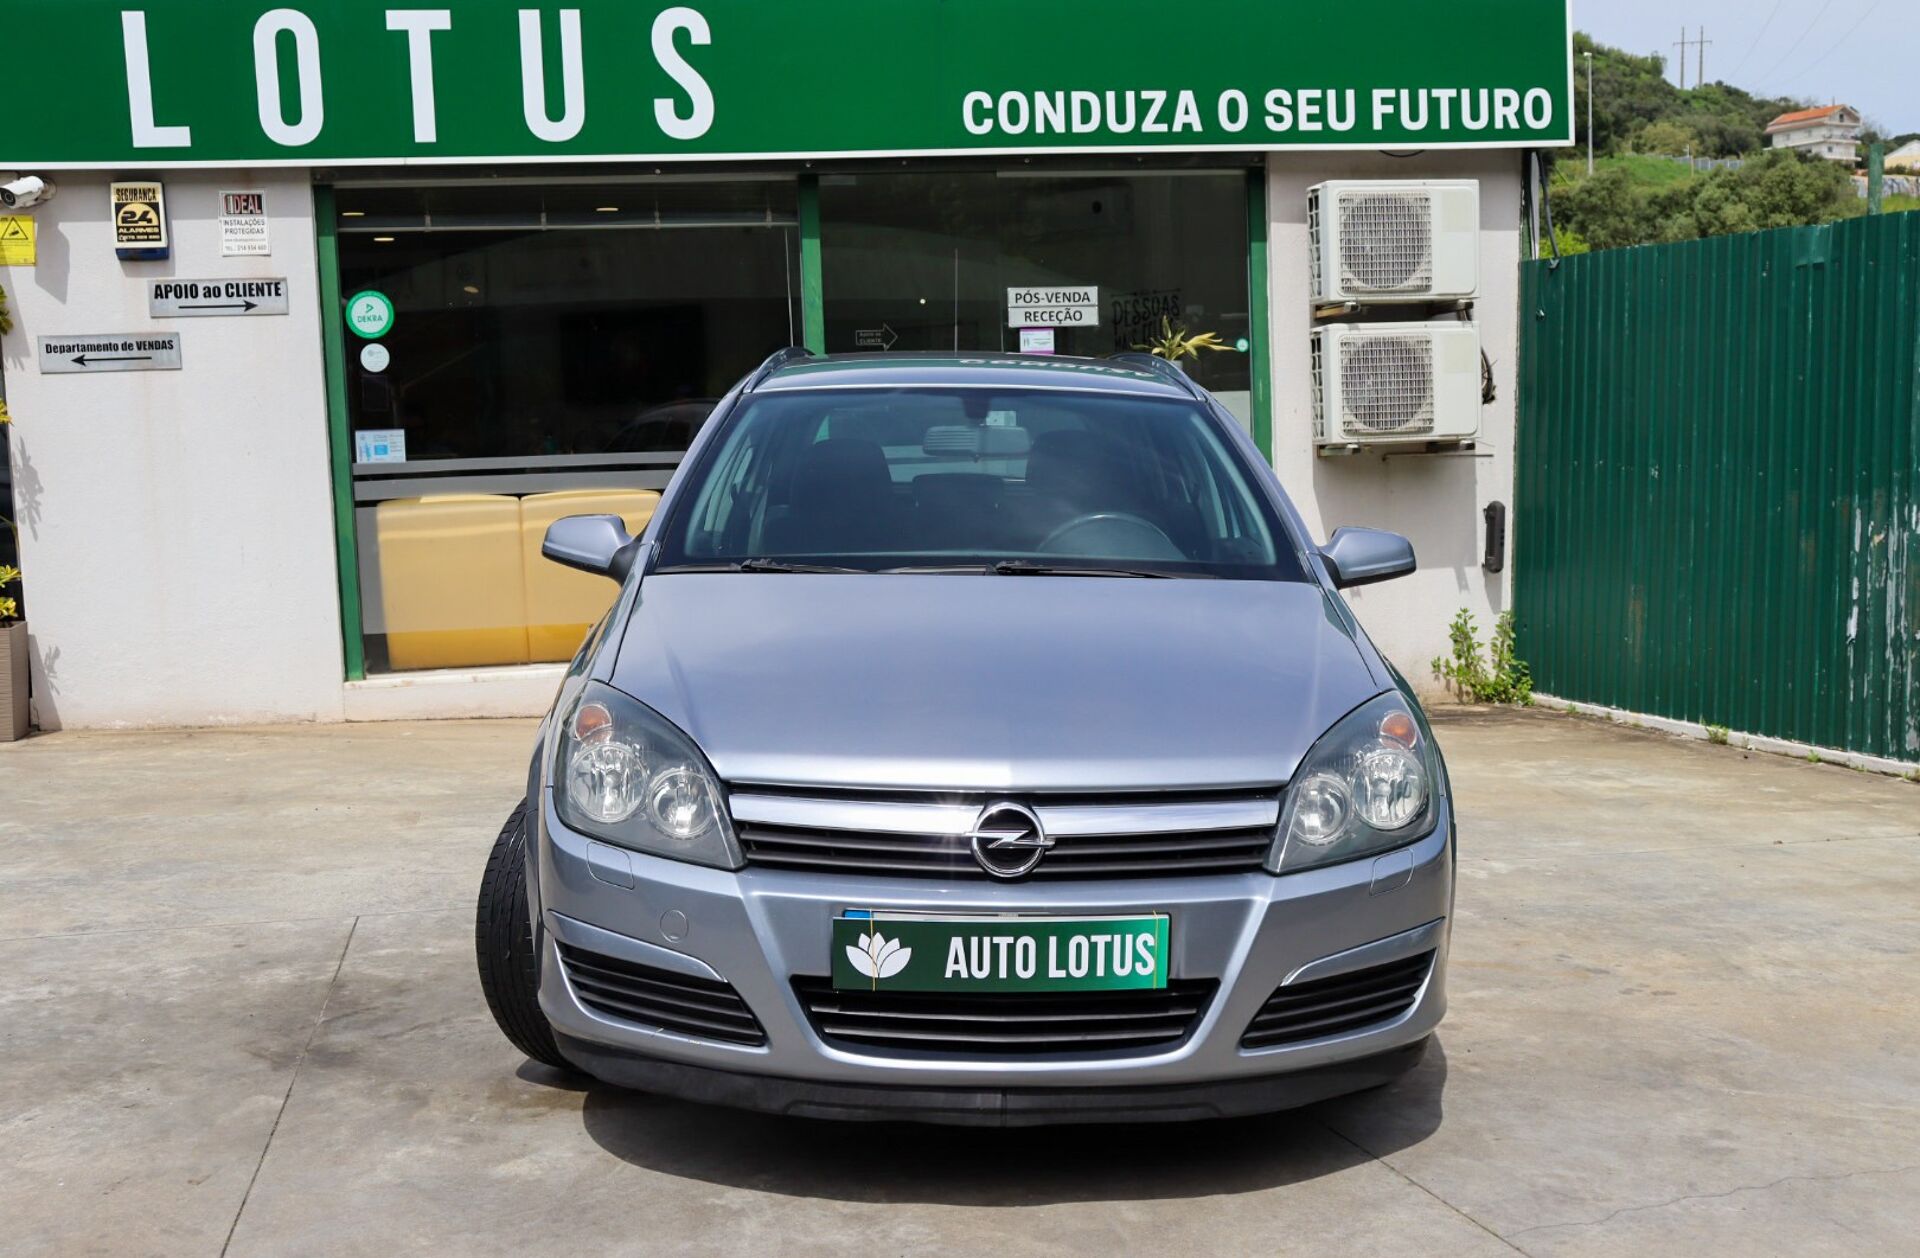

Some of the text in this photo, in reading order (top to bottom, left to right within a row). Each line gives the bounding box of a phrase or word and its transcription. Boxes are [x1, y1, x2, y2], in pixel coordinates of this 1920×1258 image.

[120, 6, 715, 148] LOTUS
[961, 87, 1553, 135] CONDUZA O SEU FUTURO
[226, 194, 262, 214] IDEAL
[121, 210, 153, 224] 24
[223, 218, 265, 227] INSTALAÇÕES
[224, 227, 265, 235] PROTEGIDAS
[154, 281, 281, 299] APOIO ao CLIENTE
[1015, 290, 1091, 304] PÓS-VENDA
[357, 315, 383, 323] DEKRA
[1024, 308, 1083, 324] RECEÇÃO
[45, 339, 174, 354] Departamento de VENDAS
[944, 932, 1155, 979] AUTO LOTUS
